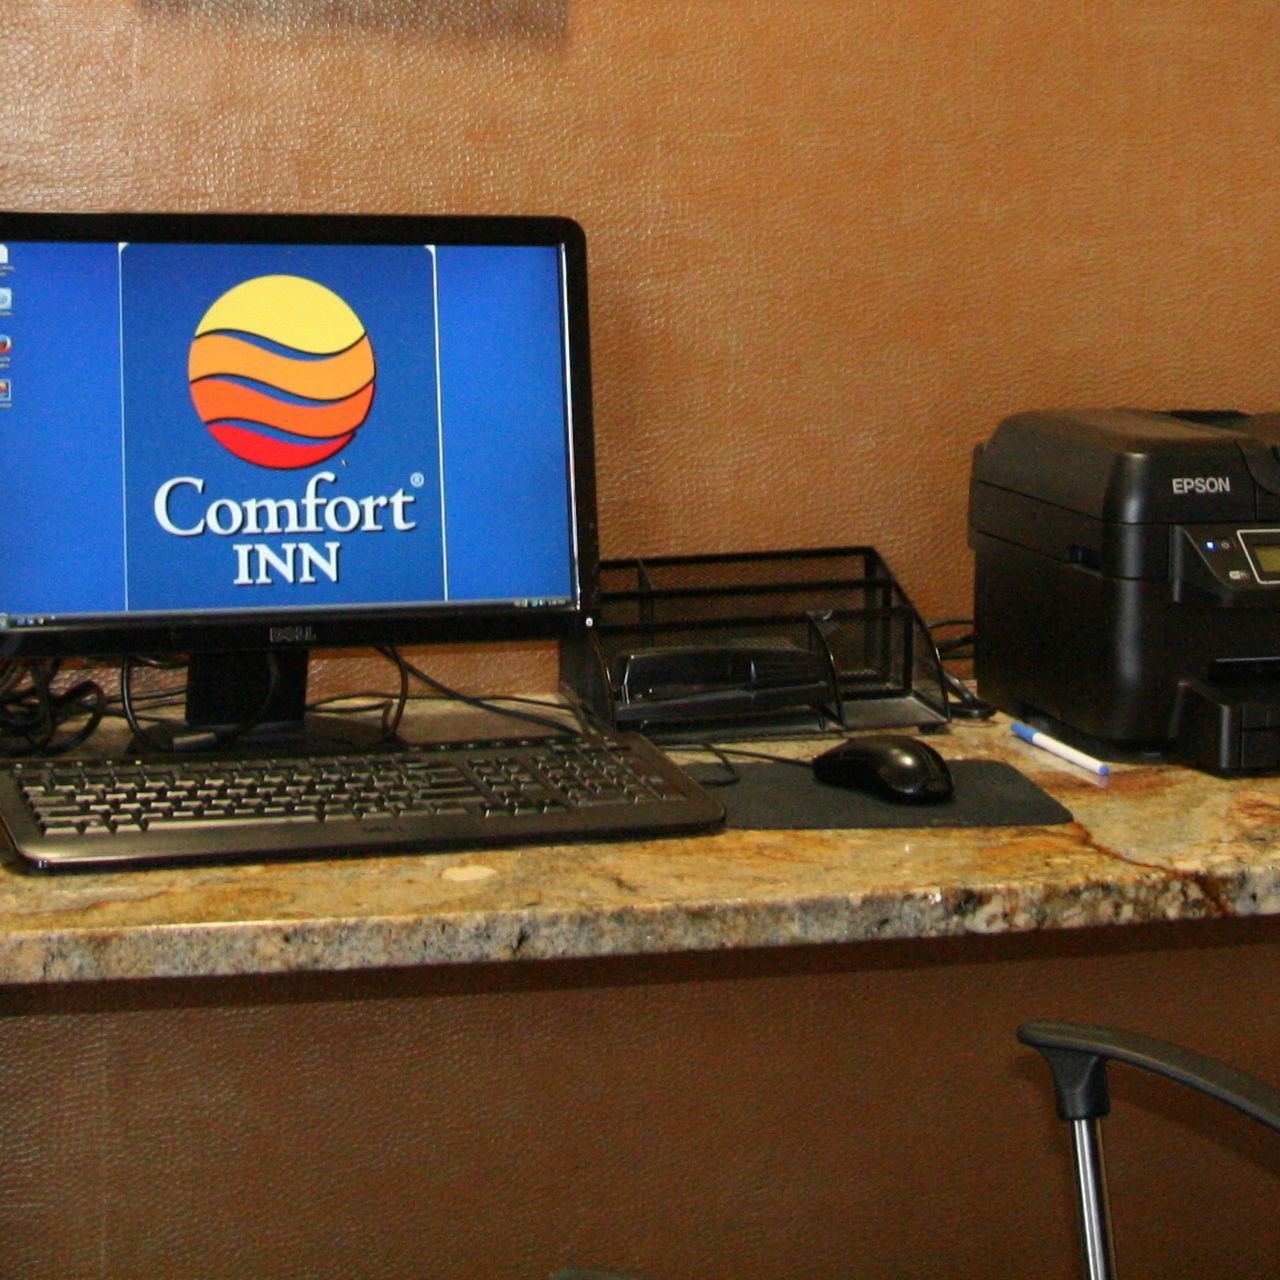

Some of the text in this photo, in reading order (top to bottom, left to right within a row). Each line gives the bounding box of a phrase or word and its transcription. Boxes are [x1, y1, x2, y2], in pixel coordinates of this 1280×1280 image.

[153, 472, 418, 537] Comfort
[1171, 476, 1231, 495] EPSON
[233, 542, 340, 587] INN
